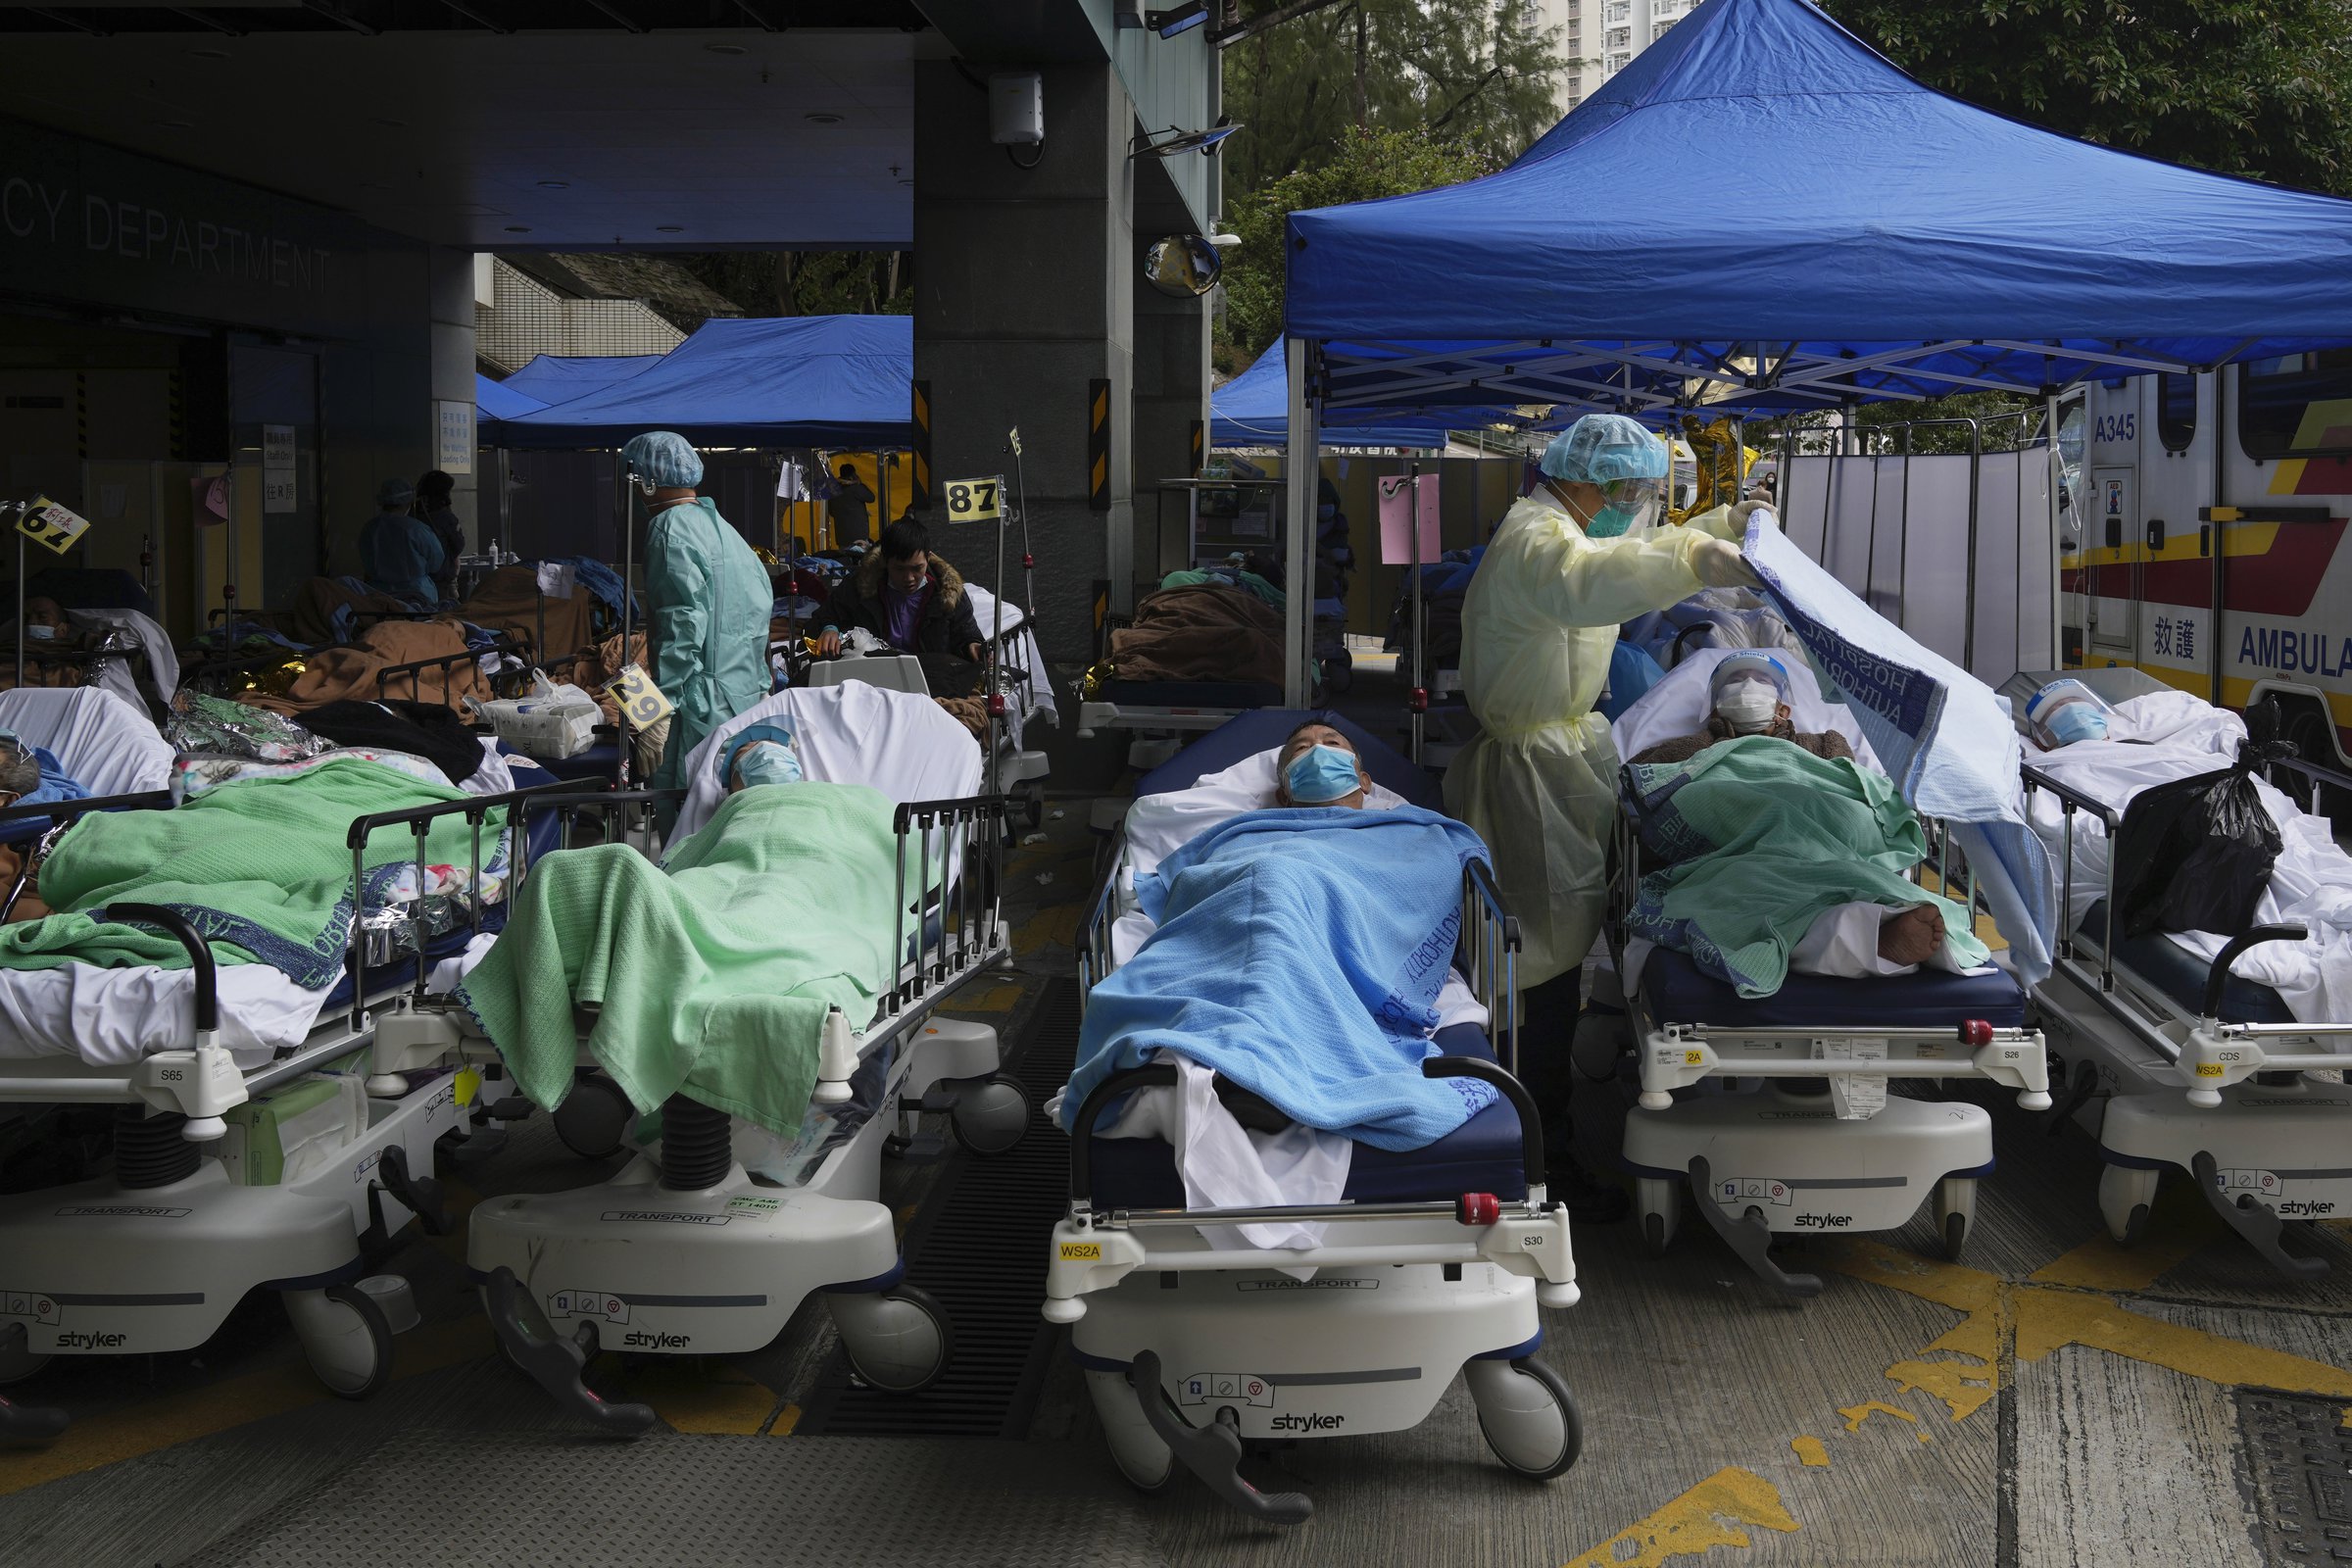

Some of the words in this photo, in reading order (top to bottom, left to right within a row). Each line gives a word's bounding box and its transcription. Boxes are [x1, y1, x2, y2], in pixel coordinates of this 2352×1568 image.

[85, 194, 330, 294] DEPARTMENT
[2094, 414, 2134, 443] A345
[280, 451, 293, 463] Only
[949, 483, 996, 513] 87
[2154, 616, 2194, 660] 救護
[1740, 650, 1765, 660] Shield
[2238, 626, 2352, 677] AMBULA
[2041, 682, 2060, 692] Face
[611, 674, 661, 722] 29
[1688, 1053, 1701, 1062] 2A
[2004, 1051, 2020, 1059] S26
[2219, 1053, 2239, 1061] CDS
[161, 1069, 183, 1081] S65
[2195, 1065, 2223, 1075] WS2A
[2278, 1200, 2334, 1216] stryker
[618, 1212, 716, 1223] TRANSPORT
[1793, 1212, 1852, 1228] stryker
[1524, 1236, 1543, 1246] S30
[1060, 1246, 1100, 1257] WS2A
[1254, 1279, 1361, 1289] TRANSPORT
[56, 1331, 126, 1349] stryker
[623, 1331, 690, 1349] stryker
[1271, 1412, 1345, 1432] stryker
